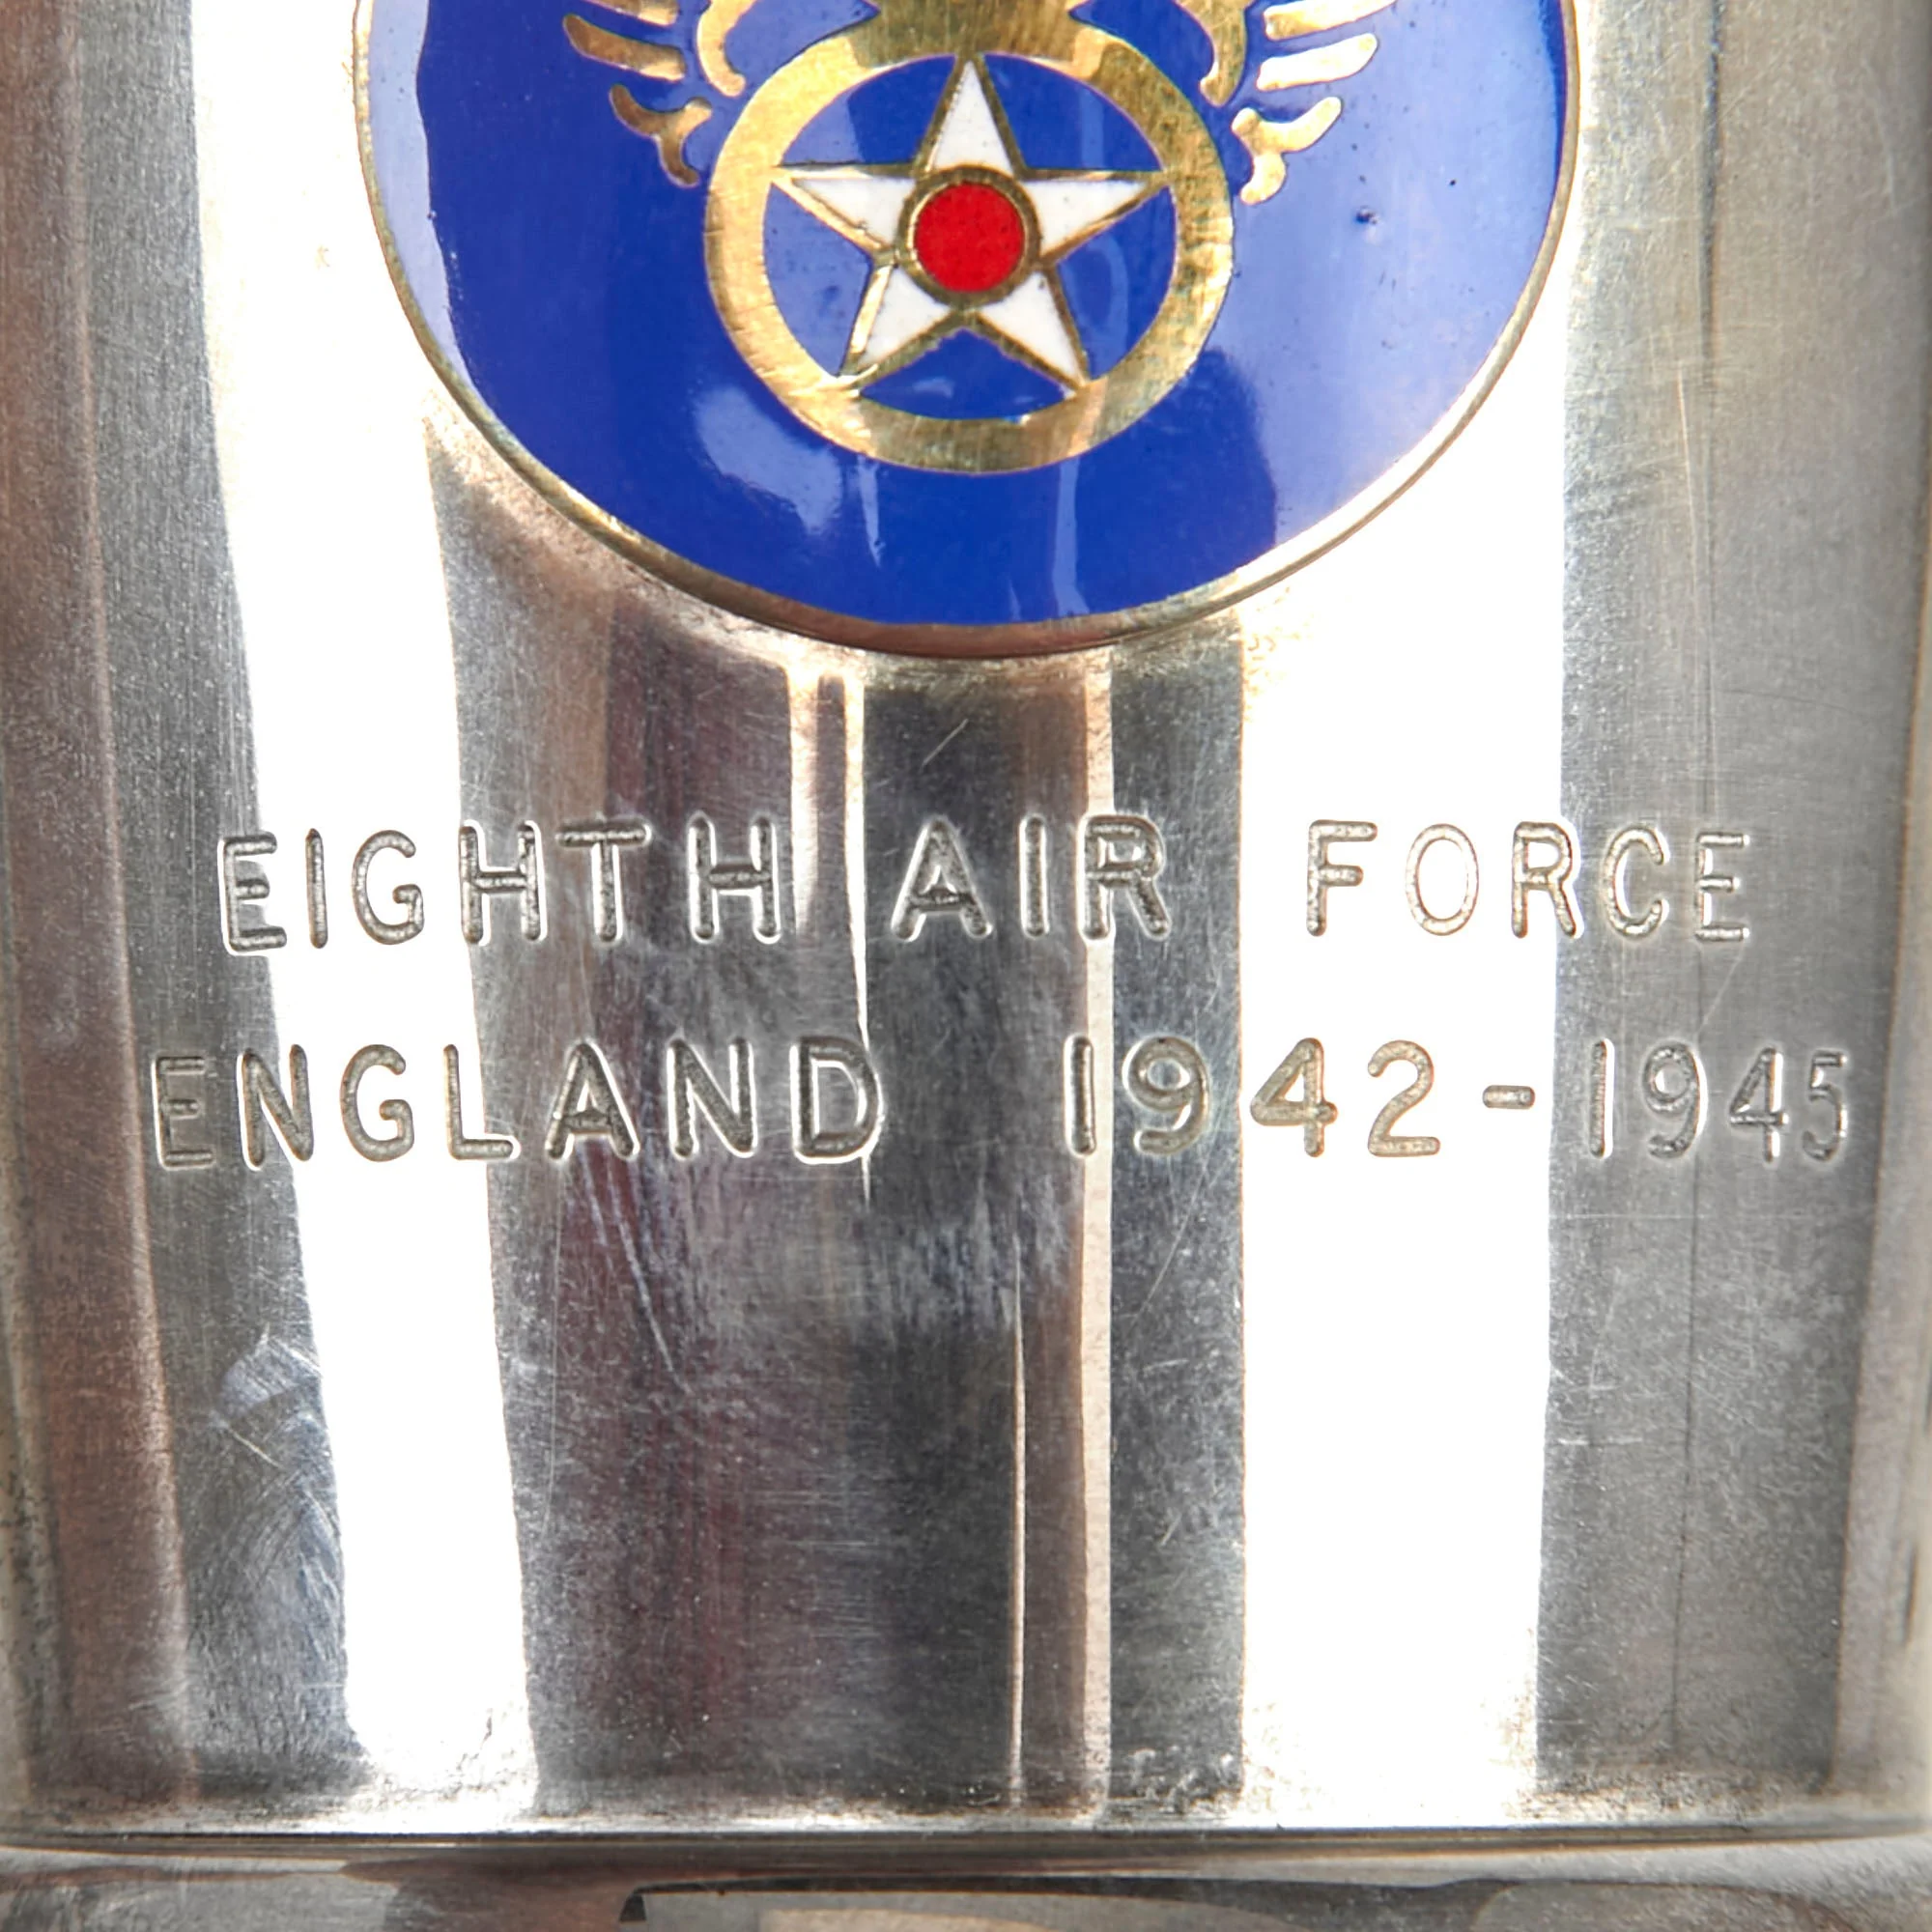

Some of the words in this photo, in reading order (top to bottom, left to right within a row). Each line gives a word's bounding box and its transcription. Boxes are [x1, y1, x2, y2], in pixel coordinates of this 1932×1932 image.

[216, 816, 783, 952] EIGHTH
[889, 812, 1172, 942] AIR
[1306, 818, 1752, 943] FORCE
[150, 1039, 886, 1171] ENGLAND
